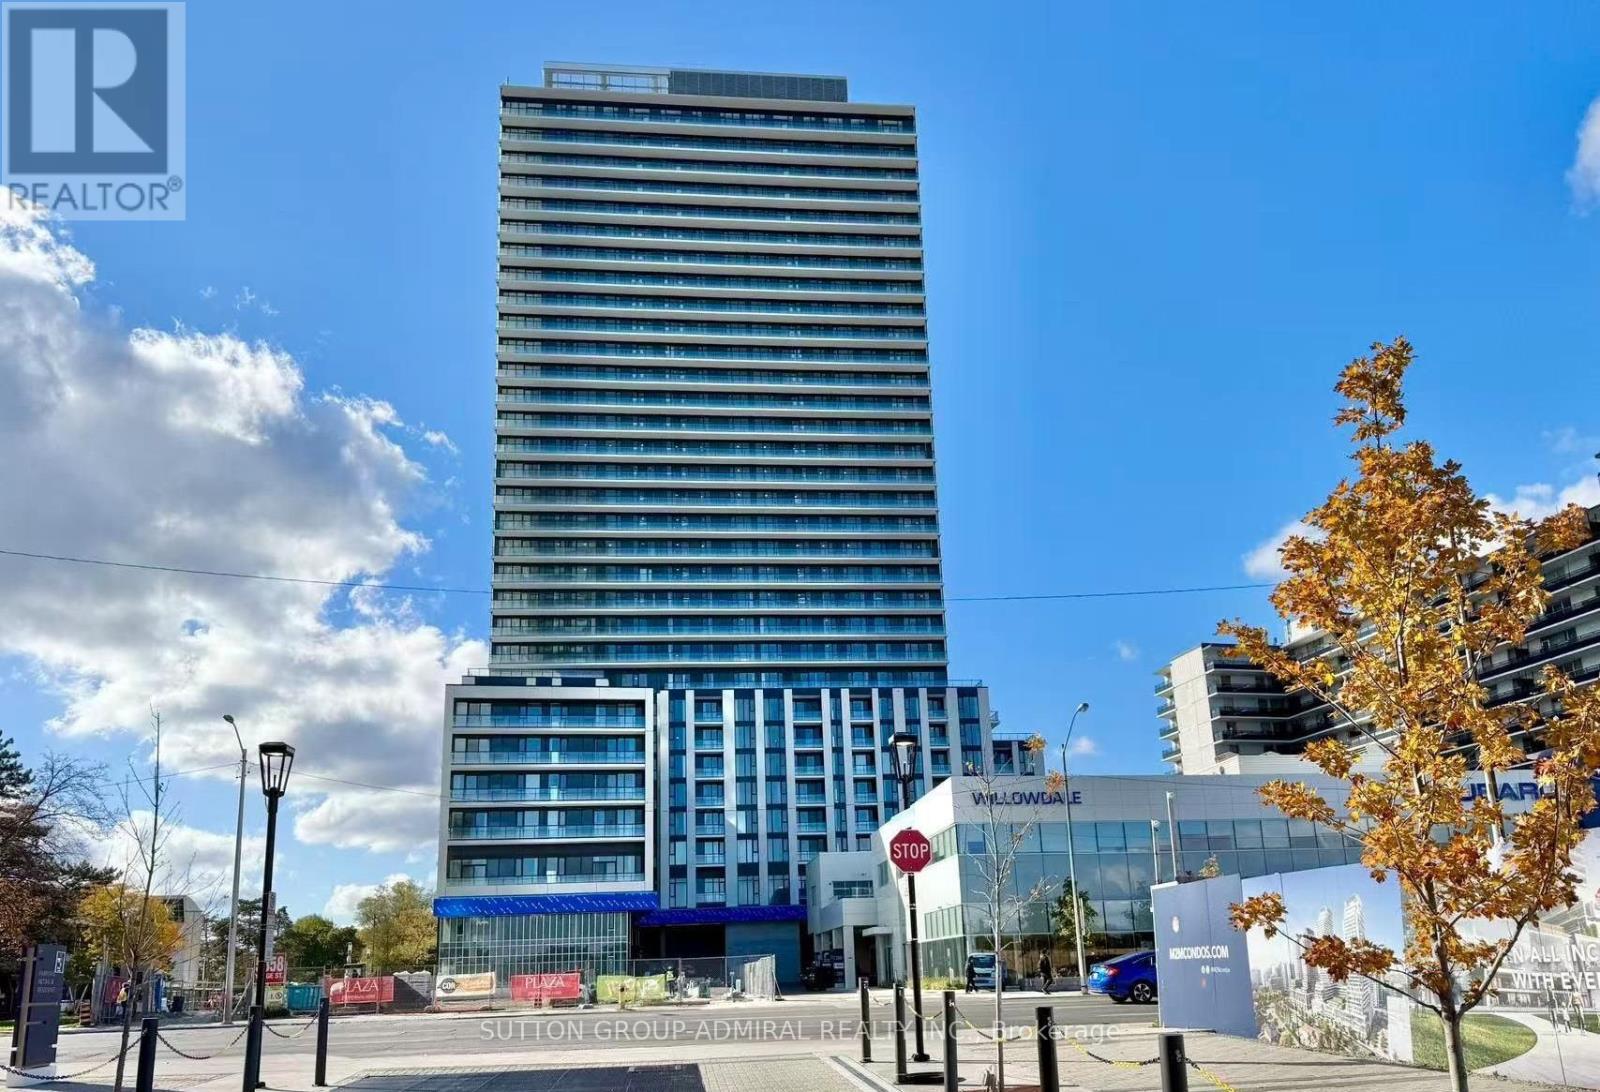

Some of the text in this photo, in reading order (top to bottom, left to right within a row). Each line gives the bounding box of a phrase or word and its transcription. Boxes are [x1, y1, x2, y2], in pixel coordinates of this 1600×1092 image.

[972, 791, 1082, 805] WILLOWDALE
[893, 843, 929, 859] STOP
[1530, 945, 1561, 963] ALL
[345, 979, 379, 993] LAZA
[525, 976, 565, 989] PLAZA
[1511, 971, 1600, 991] WITH EVE
